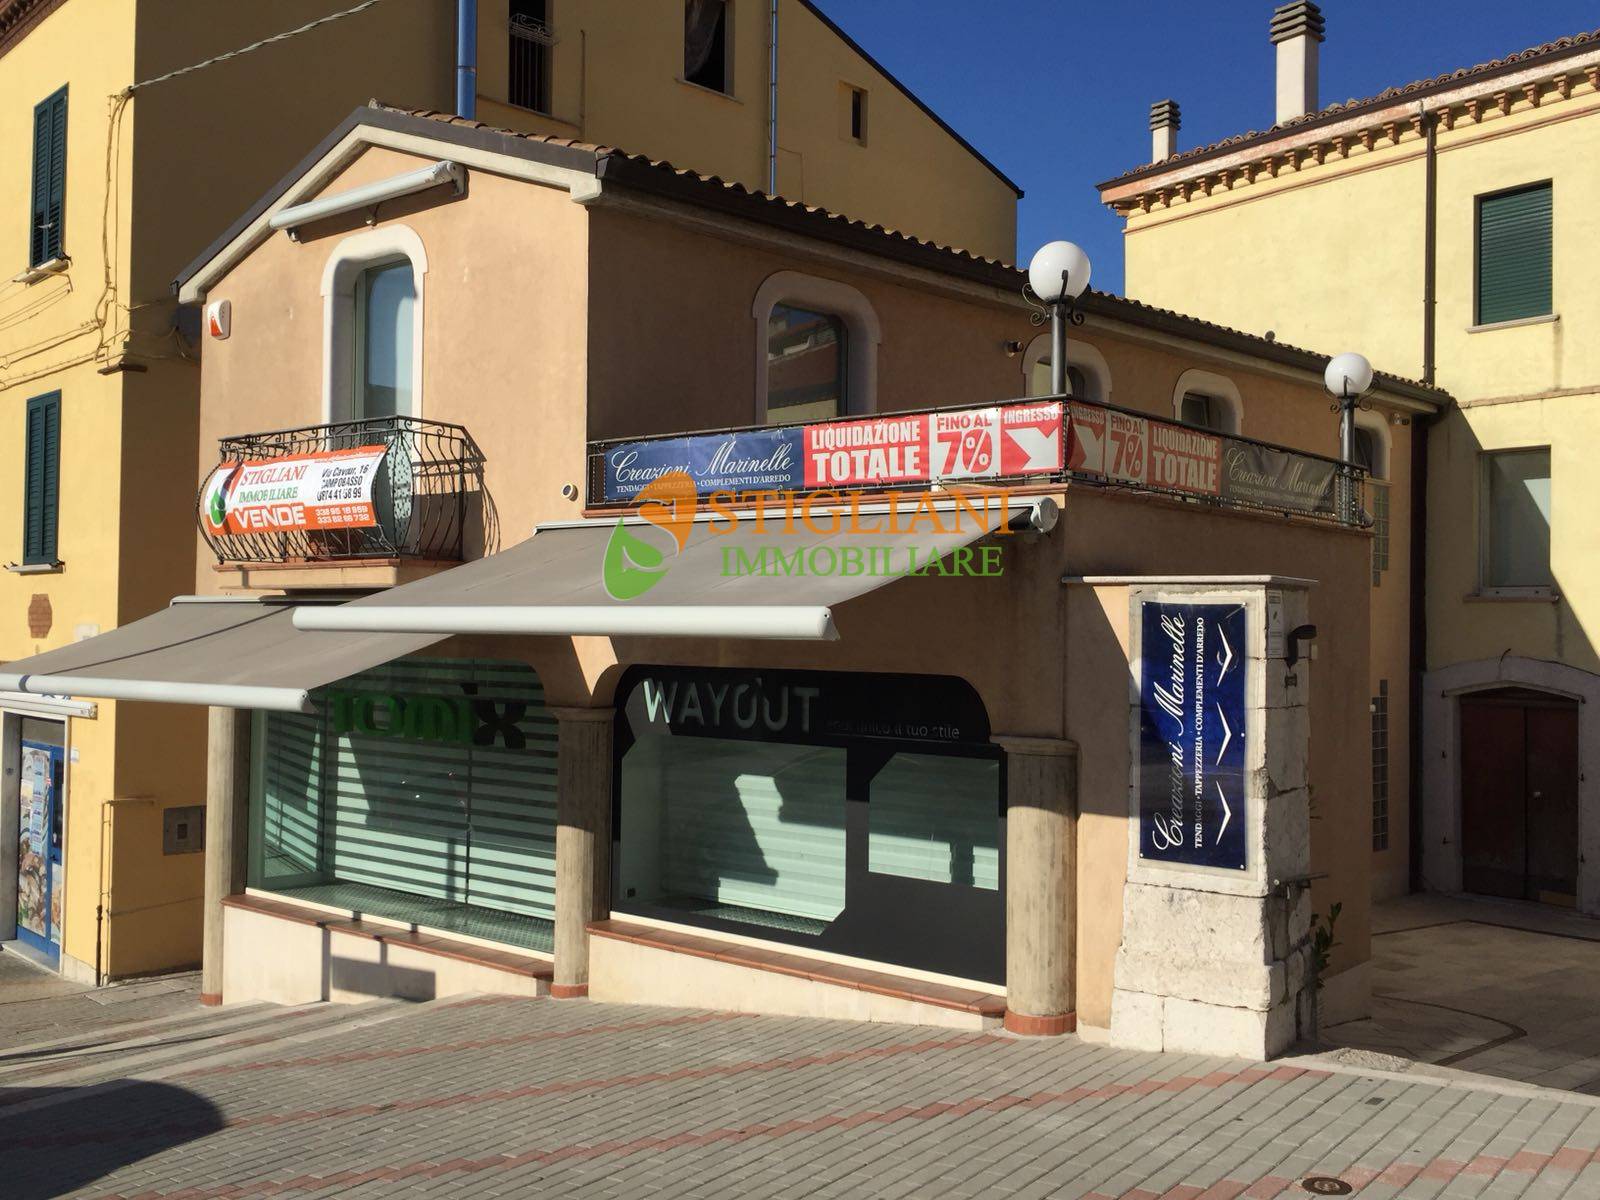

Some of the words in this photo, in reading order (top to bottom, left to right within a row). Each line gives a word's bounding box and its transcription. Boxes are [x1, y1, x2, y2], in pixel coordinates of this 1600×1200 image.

[937, 415, 971, 431] FINO
[973, 413, 992, 428] AL
[1004, 405, 1058, 424] INGRESSO
[1111, 415, 1132, 431] FINO
[811, 421, 921, 450] LIQUIDAZIONE
[1152, 426, 1218, 460] LIQUIDAZIONE
[240, 465, 309, 486] STIGLIANI
[611, 450, 692, 483] Creazioni
[695, 440, 795, 477] Marinelle
[812, 446, 921, 483] TOTALE
[1152, 449, 1217, 492] TOTALE
[239, 486, 299, 503] IMMOBILIARE
[700, 477, 752, 488] COMPLEMENTI
[753, 474, 791, 485] D'ARREDO
[234, 504, 307, 529] VENDE
[1196, 616, 1205, 663] D'ARREDO
[1153, 611, 1187, 737] Marinelle
[642, 677, 821, 735] WAYOUT
[1195, 663, 1204, 731] COMPLEMENTI
[1194, 735, 1203, 796] TAPPEZZERIA
[1152, 741, 1184, 851] Creazioni
